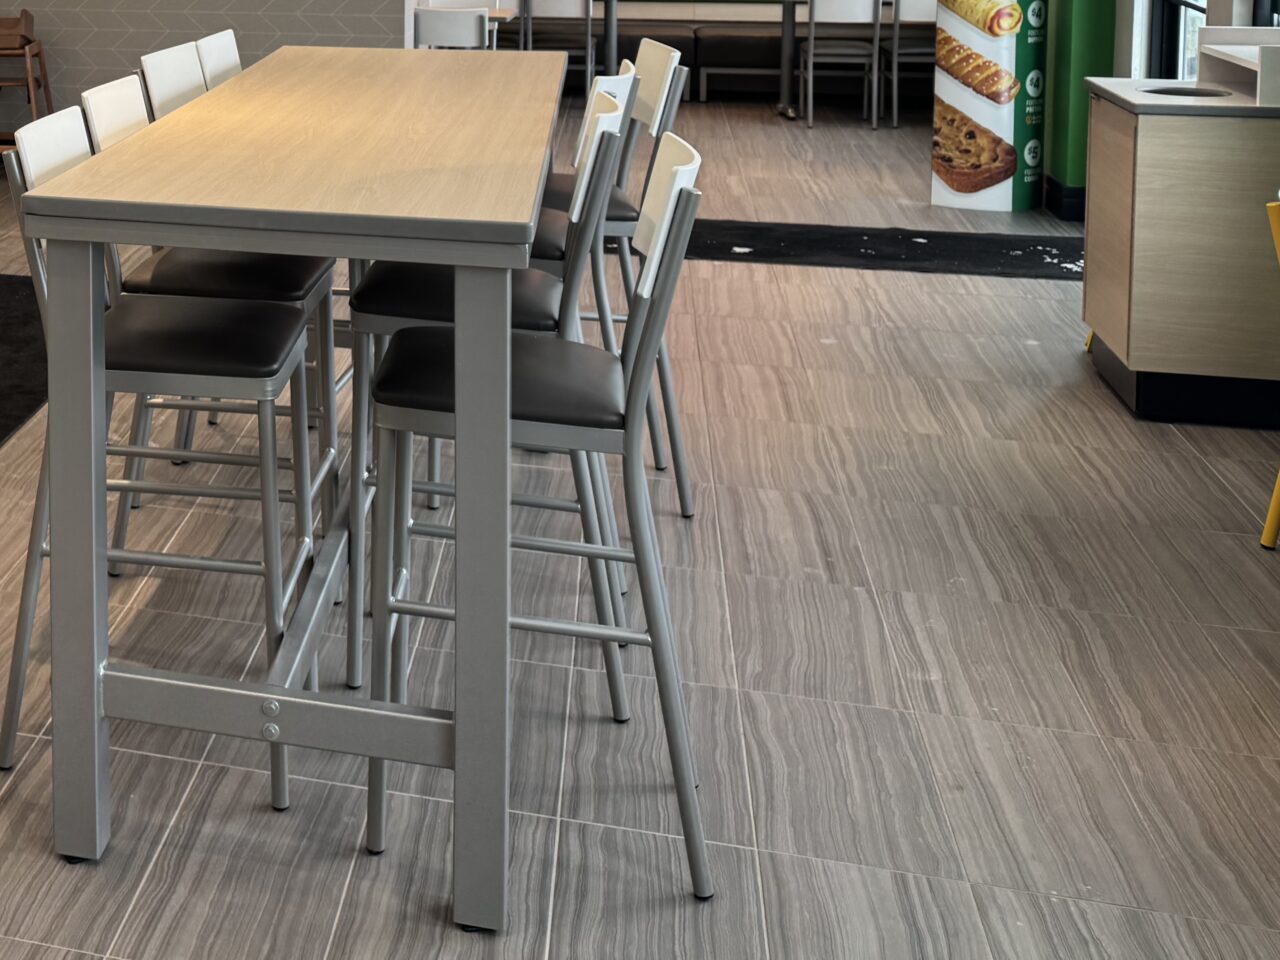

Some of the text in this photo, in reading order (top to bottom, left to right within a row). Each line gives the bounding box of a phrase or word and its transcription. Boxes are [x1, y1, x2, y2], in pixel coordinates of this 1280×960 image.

[1031, 6, 1042, 20] $4
[1030, 76, 1040, 89] $4
[1028, 145, 1038, 160] $5
